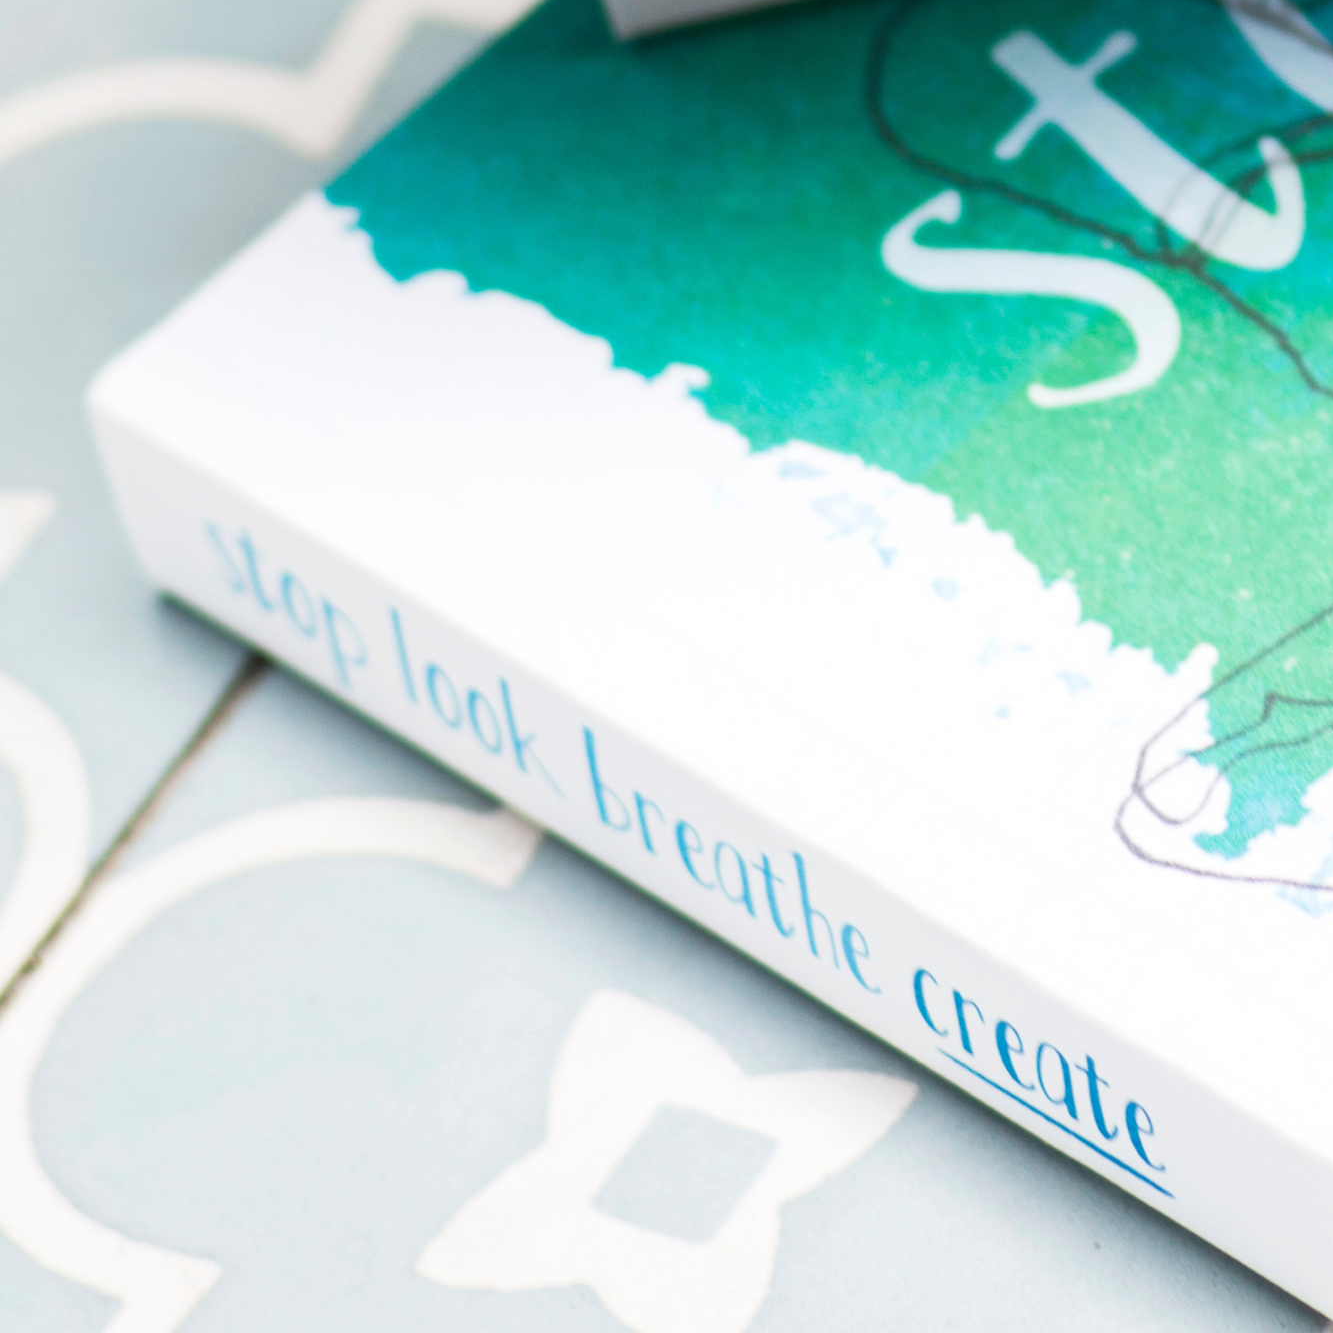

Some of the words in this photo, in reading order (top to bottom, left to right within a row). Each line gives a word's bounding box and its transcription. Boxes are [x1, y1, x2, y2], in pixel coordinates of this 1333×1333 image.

[206, 518, 369, 687] stop
[390, 605, 565, 799] look
[581, 726, 882, 994] breathe
[912, 967, 1167, 1173] create
